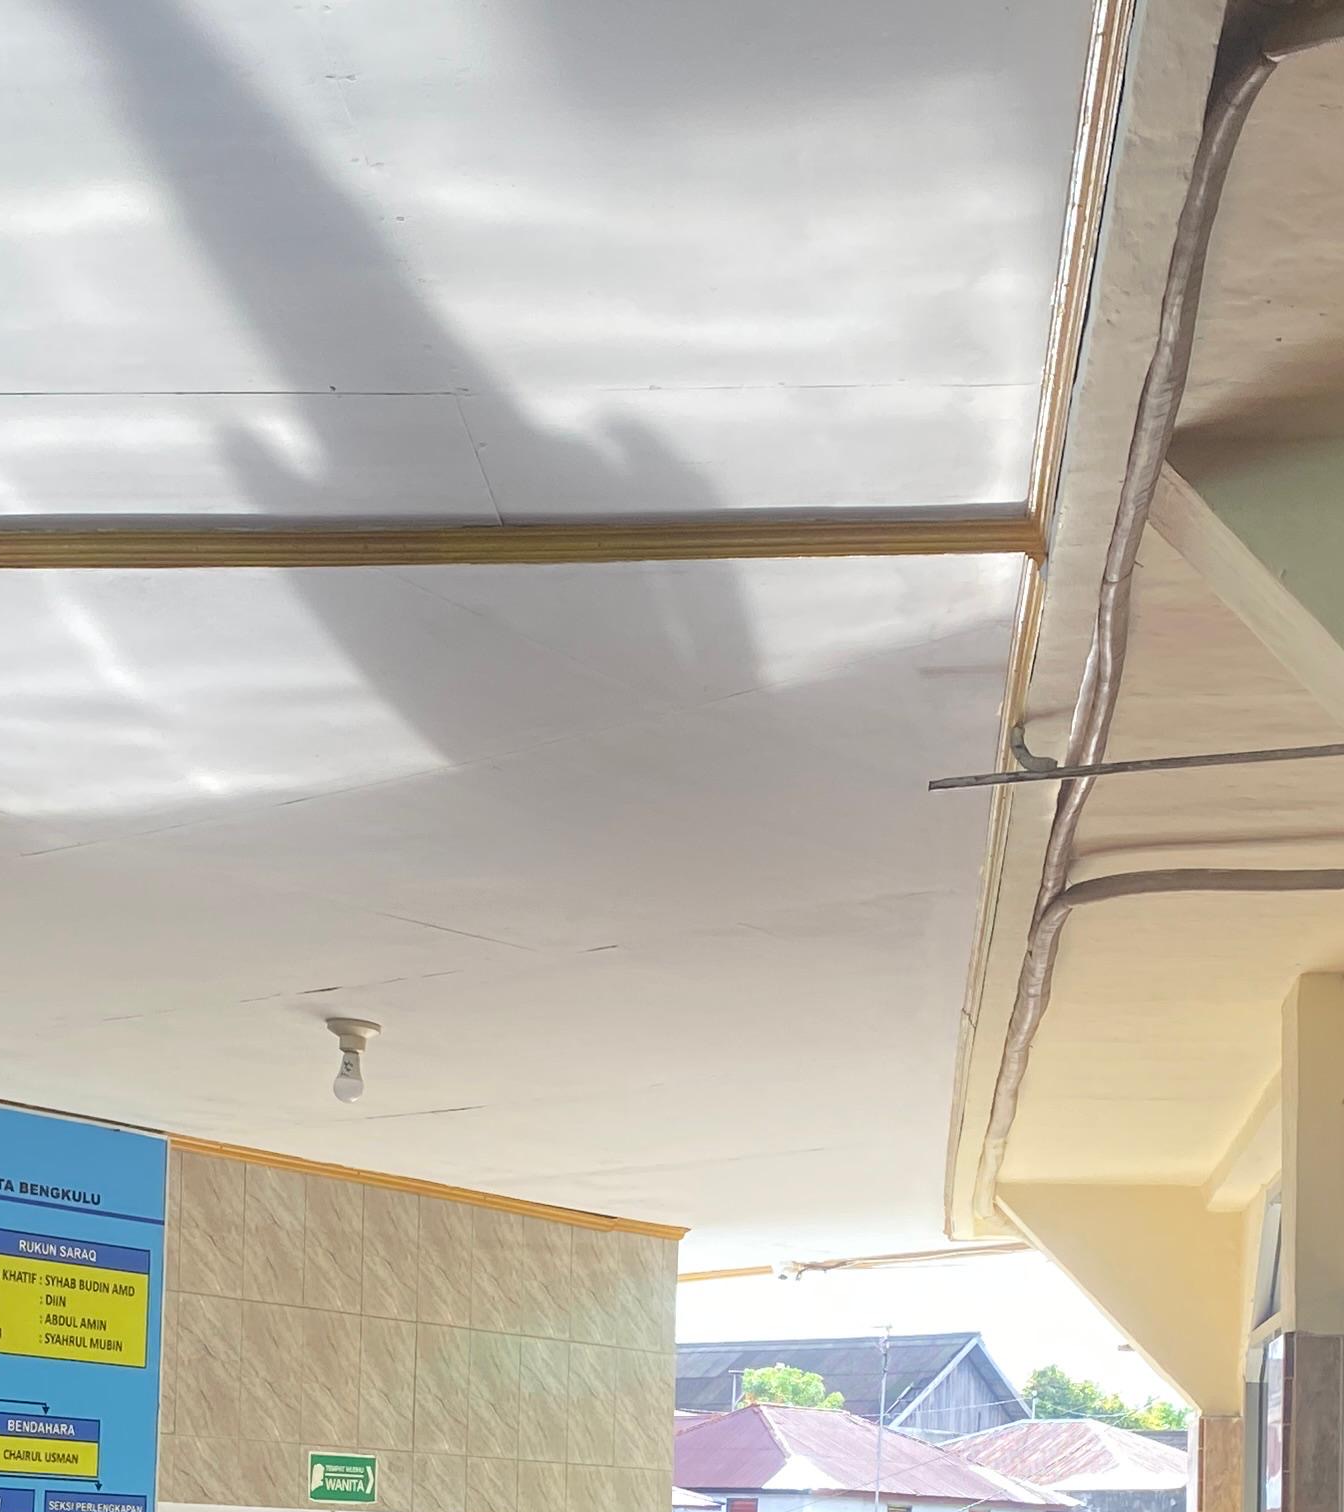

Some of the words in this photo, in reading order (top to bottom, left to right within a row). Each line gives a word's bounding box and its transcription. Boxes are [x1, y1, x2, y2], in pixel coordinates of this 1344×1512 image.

[19, 1182, 101, 1206] BENGKULU
[19, 1240, 56, 1256] RUKUN
[60, 1246, 97, 1262] SARAQ
[2, 1269, 36, 1284] KHATIF
[45, 1276, 76, 1289] SYHAB
[79, 1281, 109, 1294] BUDIN
[112, 1285, 135, 1297] AMD
[45, 1314, 78, 1328] ABDUL
[80, 1319, 106, 1331] AMIN
[45, 1333, 86, 1348] SYAHRUL
[90, 1338, 122, 1352] MUBIN
[8, 1420, 75, 1436] BENDAHARA
[3, 1449, 42, 1462] CHAIRUL
[45, 1452, 79, 1464] USMAN
[325, 1478, 365, 1492] WANITA
[49, 1501, 74, 1511] SEKSI
